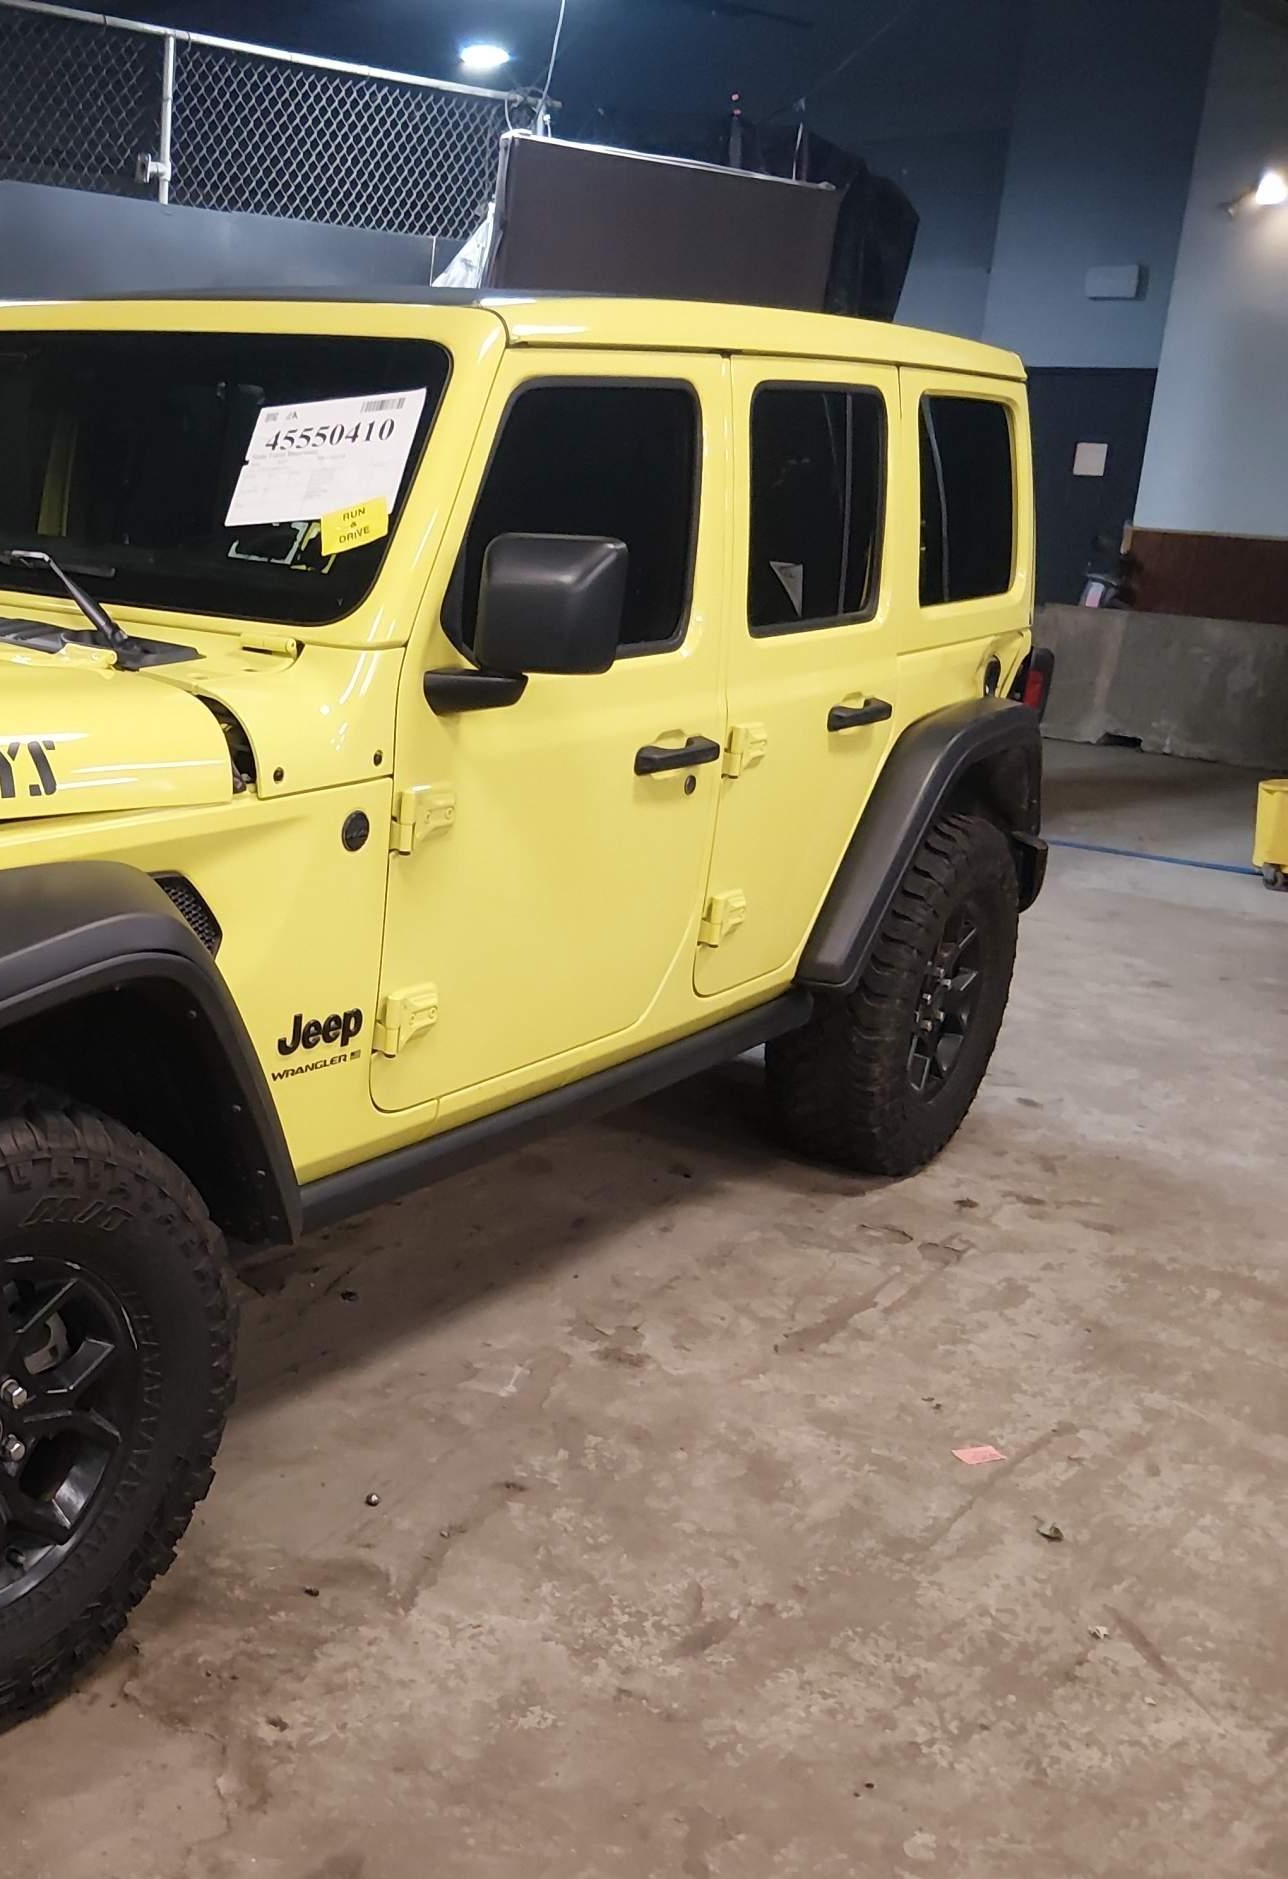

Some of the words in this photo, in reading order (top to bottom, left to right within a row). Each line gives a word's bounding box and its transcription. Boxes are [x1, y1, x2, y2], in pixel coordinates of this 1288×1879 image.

[265, 418, 395, 451] 45550410
[342, 506, 366, 521] RUN
[339, 526, 370, 544] DRIVE
[277, 1008, 363, 1056] Jeep
[271, 1053, 347, 1082] WRANGLER
